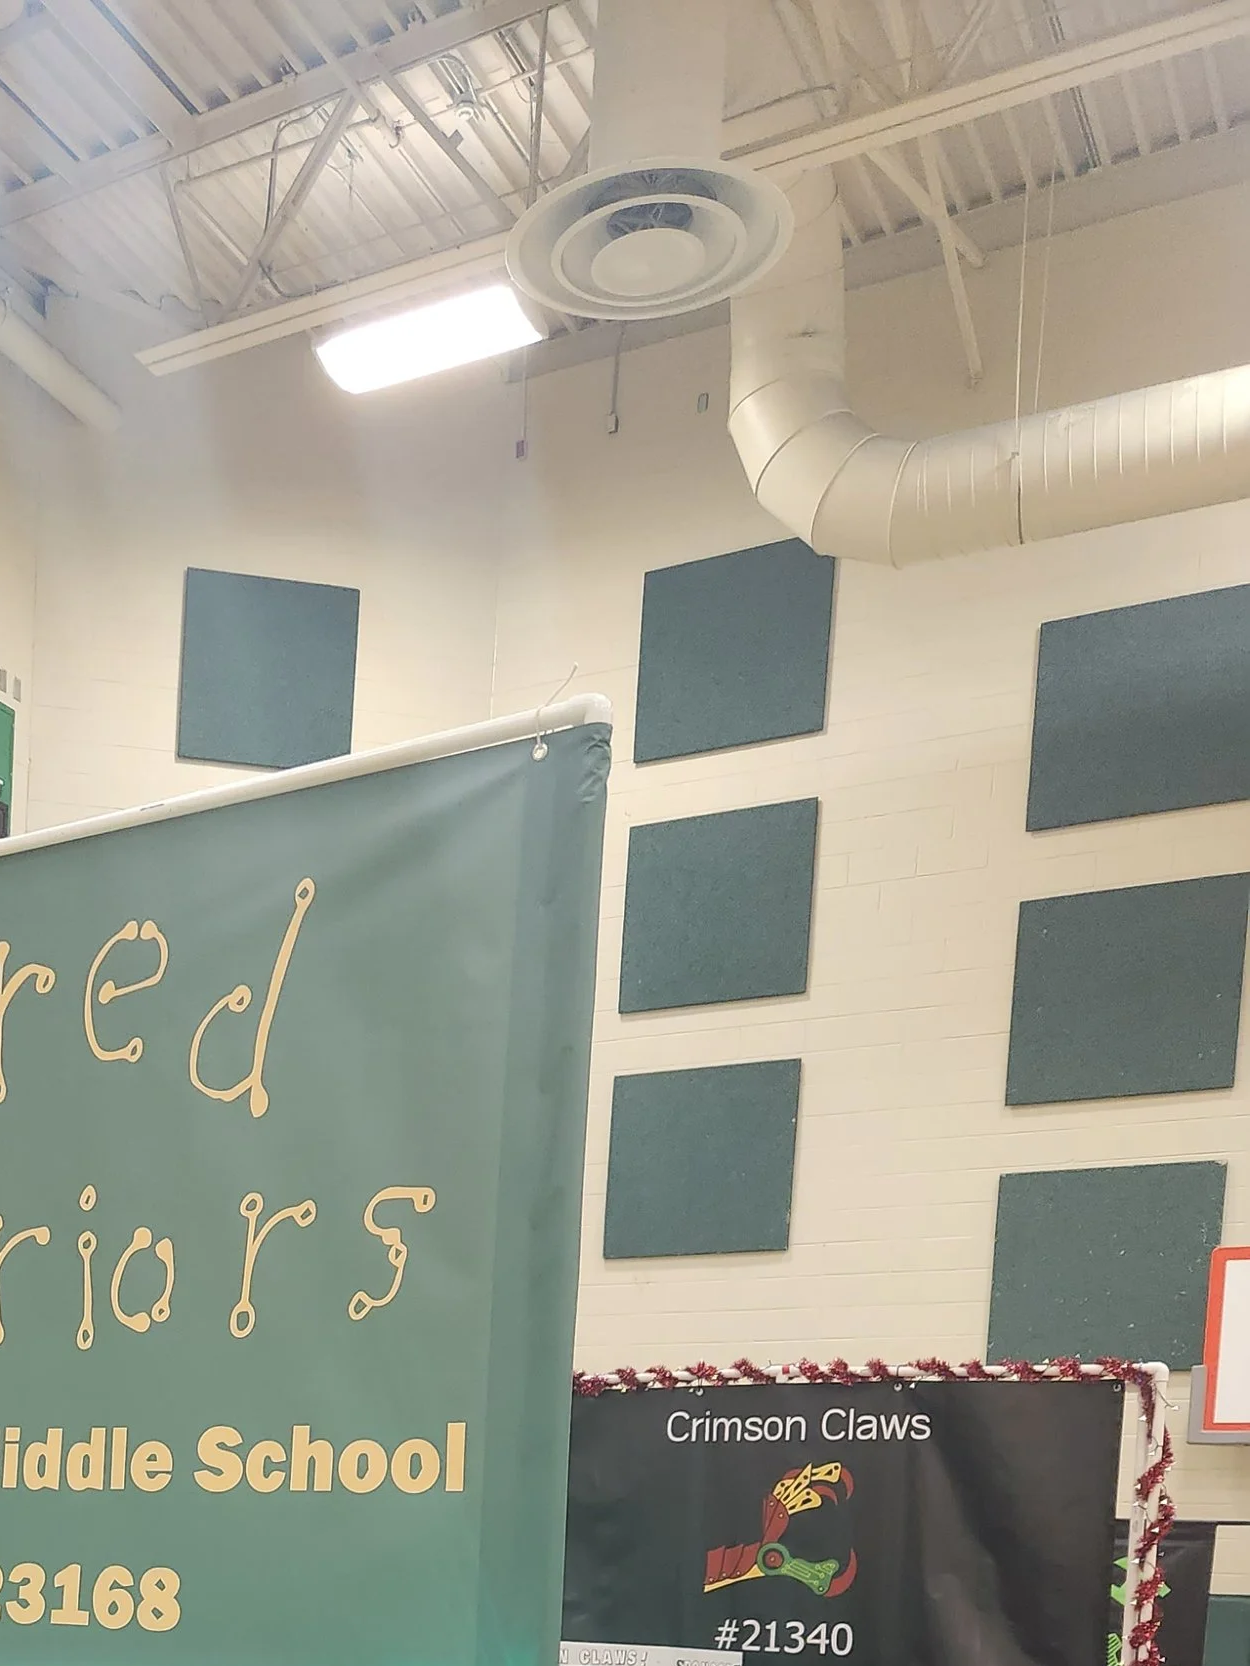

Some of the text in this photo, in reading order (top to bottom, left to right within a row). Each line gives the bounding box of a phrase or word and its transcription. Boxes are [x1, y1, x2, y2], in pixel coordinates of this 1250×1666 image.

[666, 1408, 932, 1443] Crimson Claws
[193, 1421, 466, 1495] School
[715, 1620, 855, 1655] #21340
